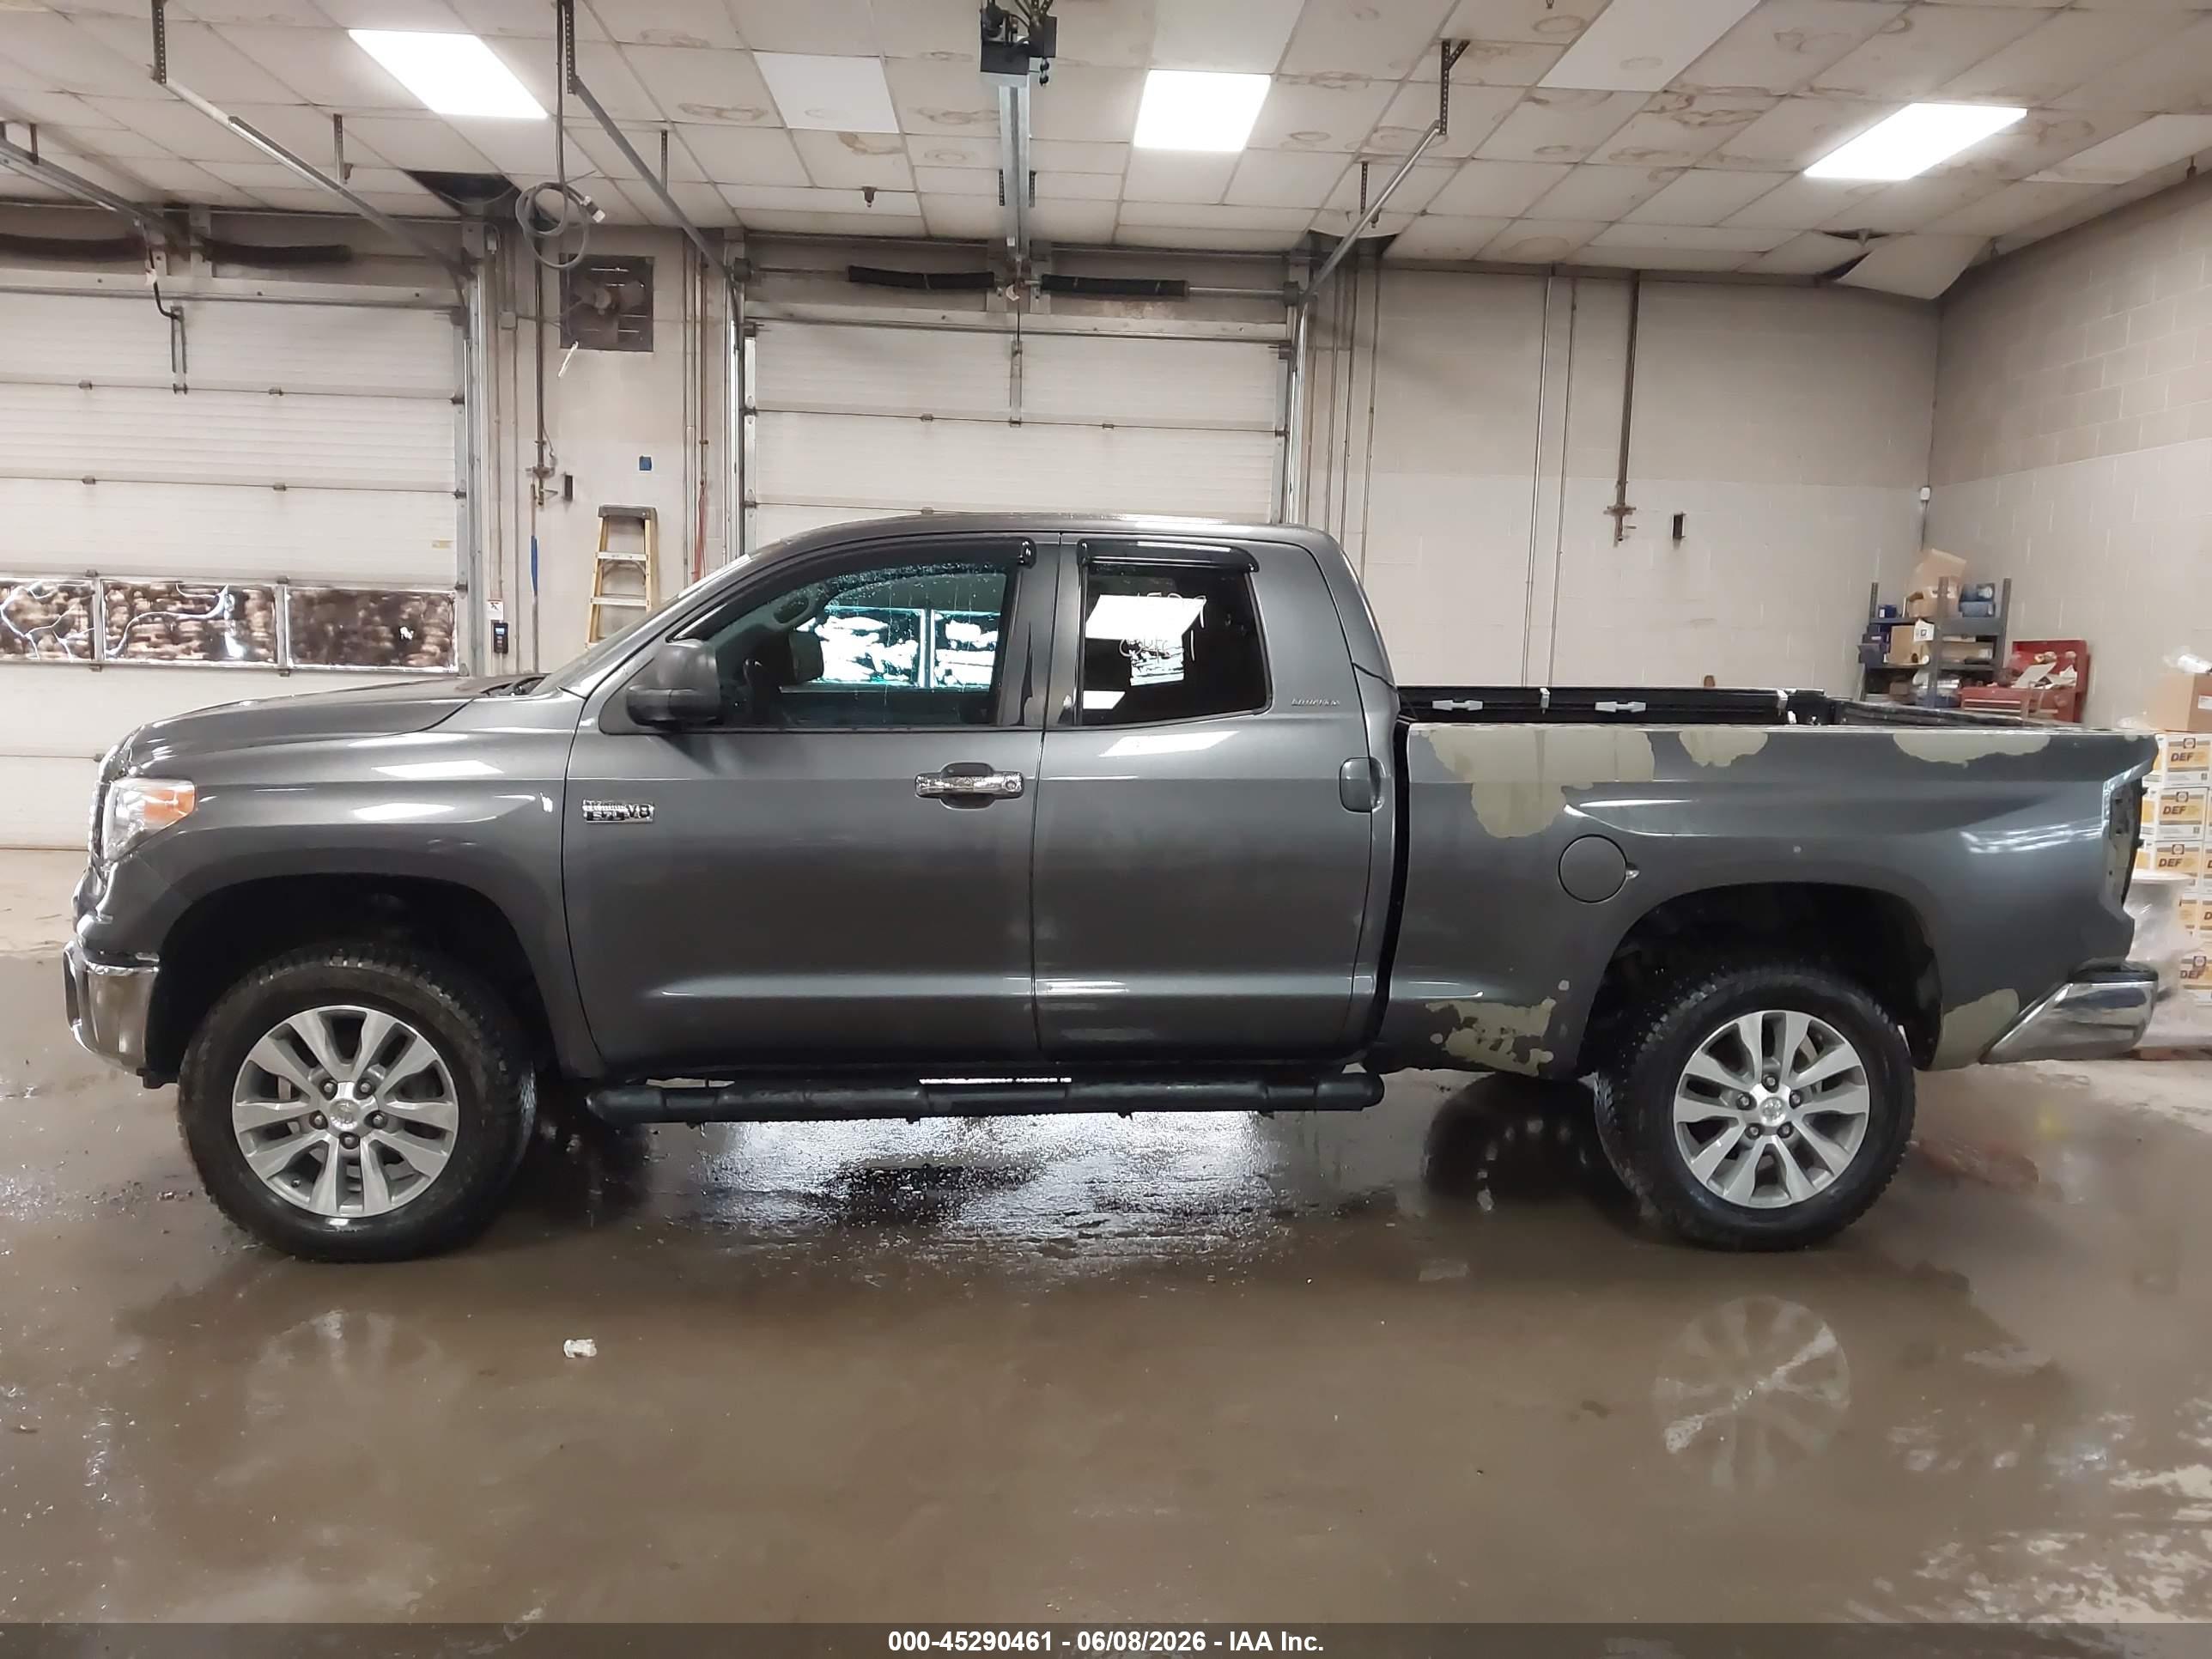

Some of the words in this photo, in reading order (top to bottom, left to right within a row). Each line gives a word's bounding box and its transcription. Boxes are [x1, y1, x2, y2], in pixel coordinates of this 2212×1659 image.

[2171, 752, 2194, 763] DEF
[2162, 805, 2186, 815] DEF
[2158, 858, 2183, 867] DEF
